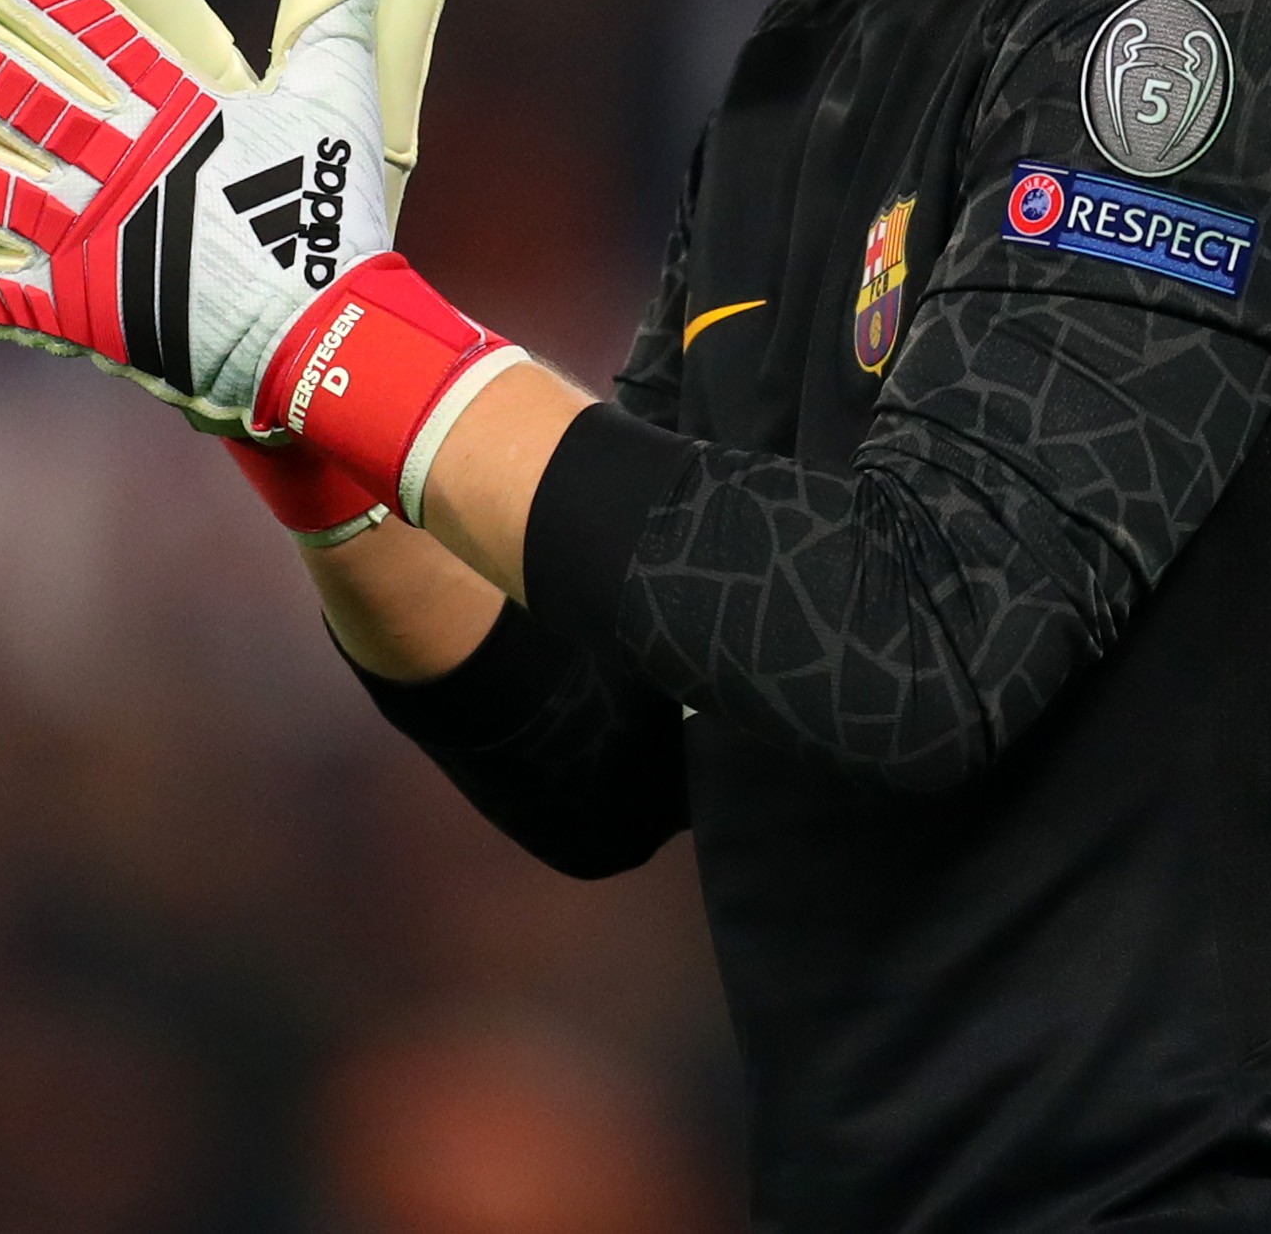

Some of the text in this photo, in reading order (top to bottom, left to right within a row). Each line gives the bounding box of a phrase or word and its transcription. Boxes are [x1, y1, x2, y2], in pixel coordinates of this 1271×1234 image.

[1136, 78, 1172, 124] 5
[1024, 177, 1056, 194] UEFA
[299, 137, 351, 290] adidas
[1067, 195, 1251, 271] RESPECT
[321, 366, 350, 397] D
